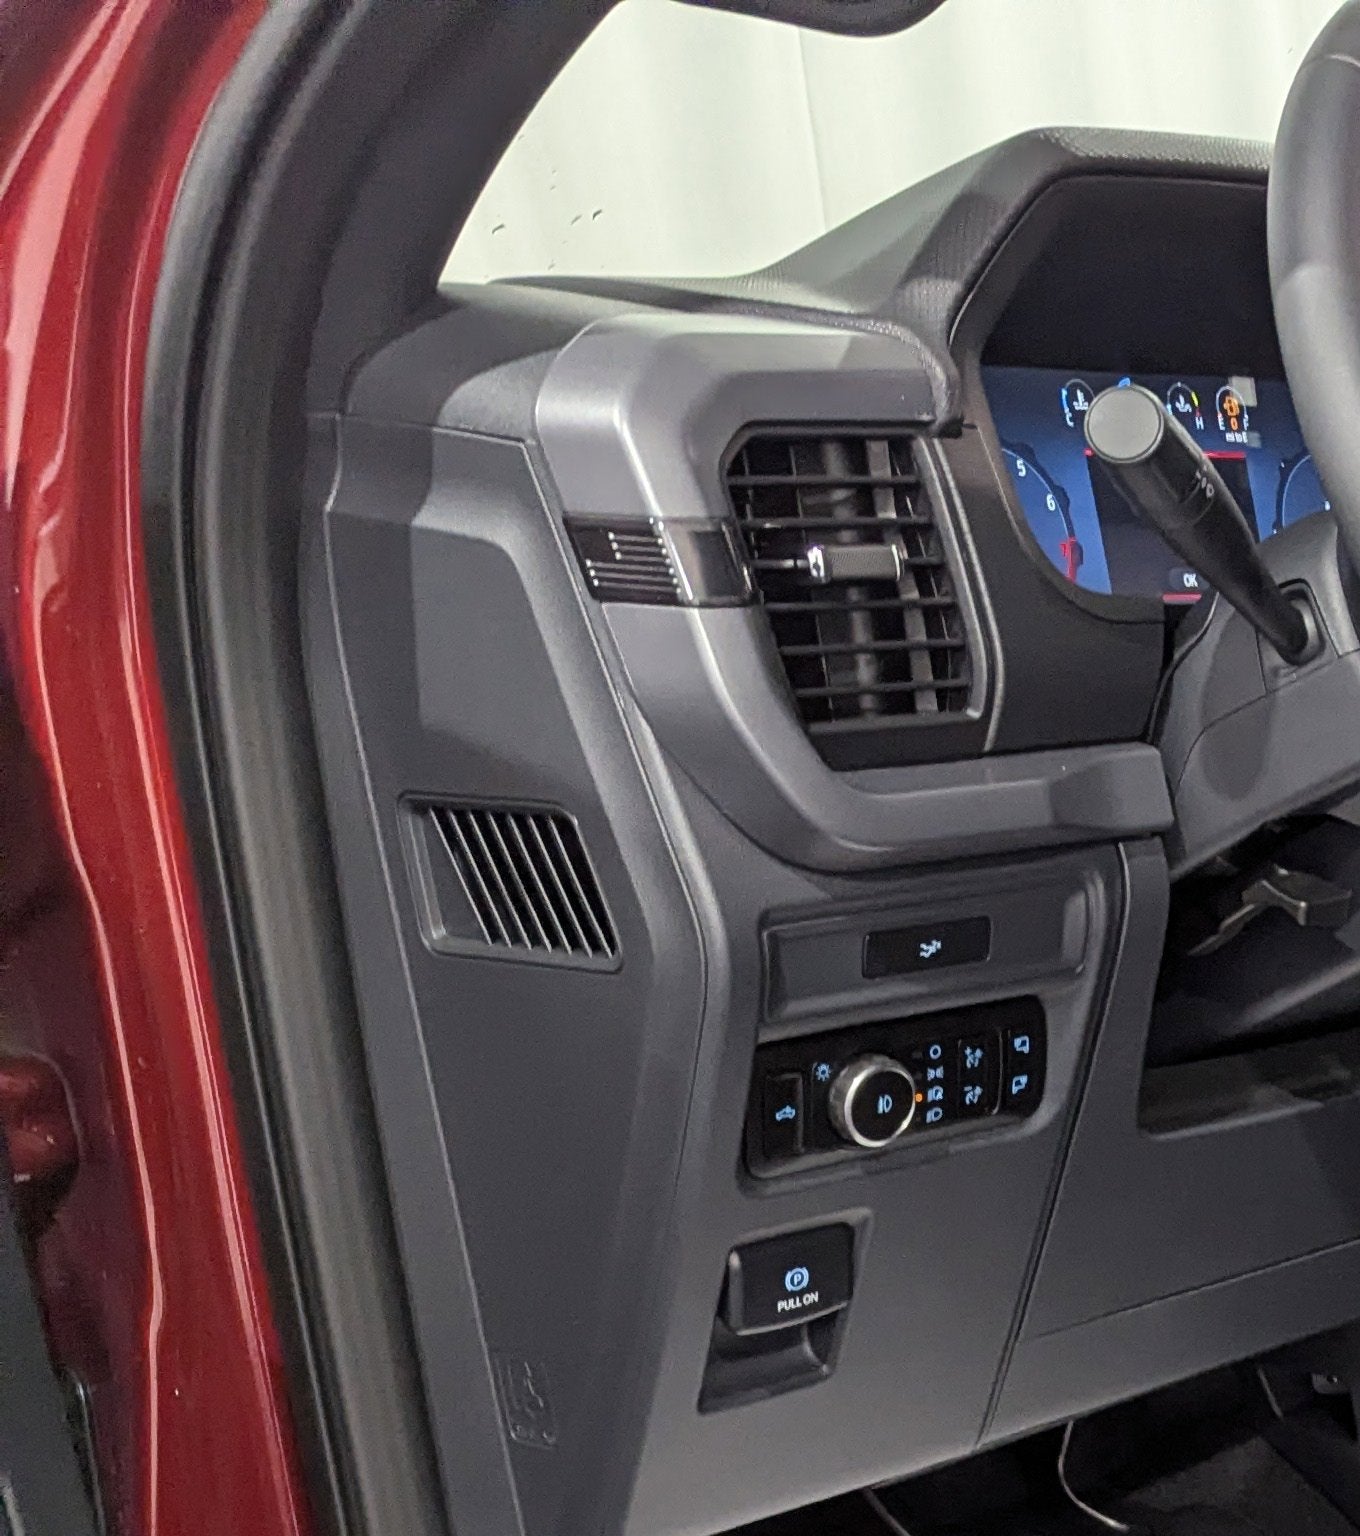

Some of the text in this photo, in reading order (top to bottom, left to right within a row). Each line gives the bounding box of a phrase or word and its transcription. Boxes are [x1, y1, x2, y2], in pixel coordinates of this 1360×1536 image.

[1195, 416, 1204, 430] H
[1016, 458, 1027, 477] 5
[1046, 493, 1056, 511] 6
[1183, 573, 1199, 588] OK
[777, 1290, 819, 1313] PULL ON
